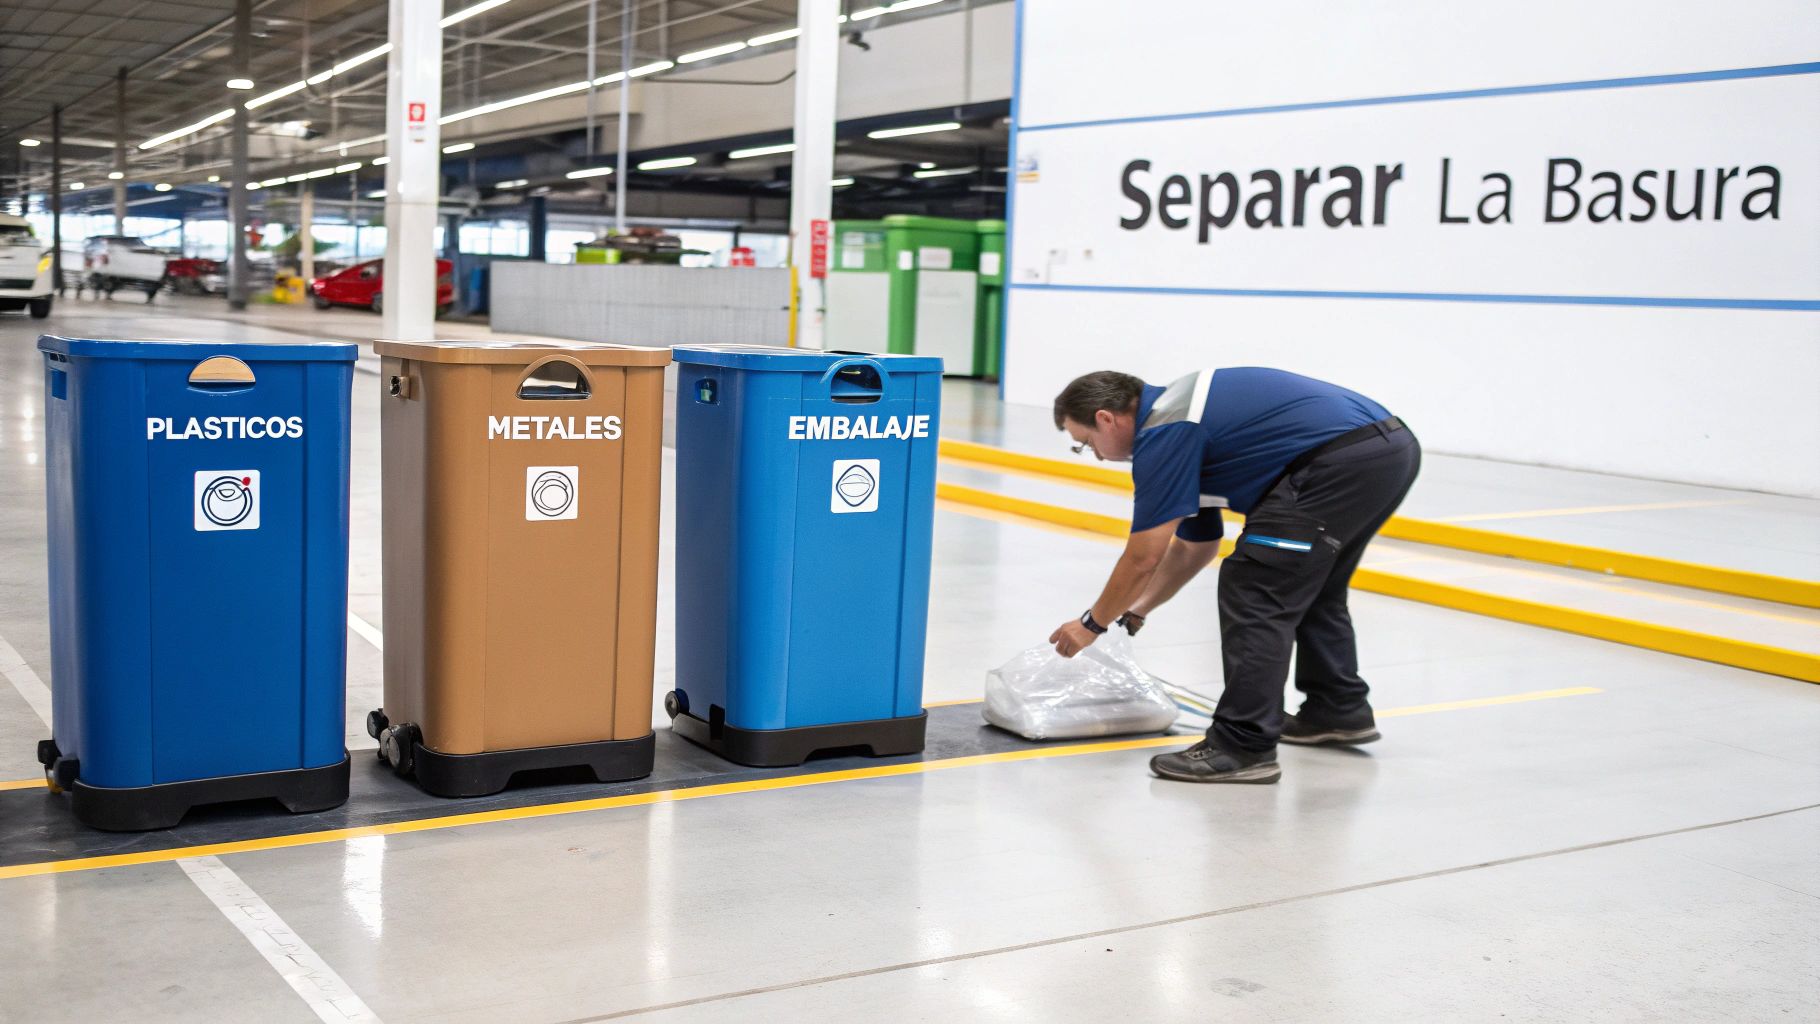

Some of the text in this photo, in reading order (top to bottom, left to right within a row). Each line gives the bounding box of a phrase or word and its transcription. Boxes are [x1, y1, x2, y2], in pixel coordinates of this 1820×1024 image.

[1119, 157, 1782, 244] Separar La Basura
[146, 415, 304, 440] PLASTICOS
[488, 415, 622, 440] METALES
[788, 414, 931, 441] EMBALAJE
